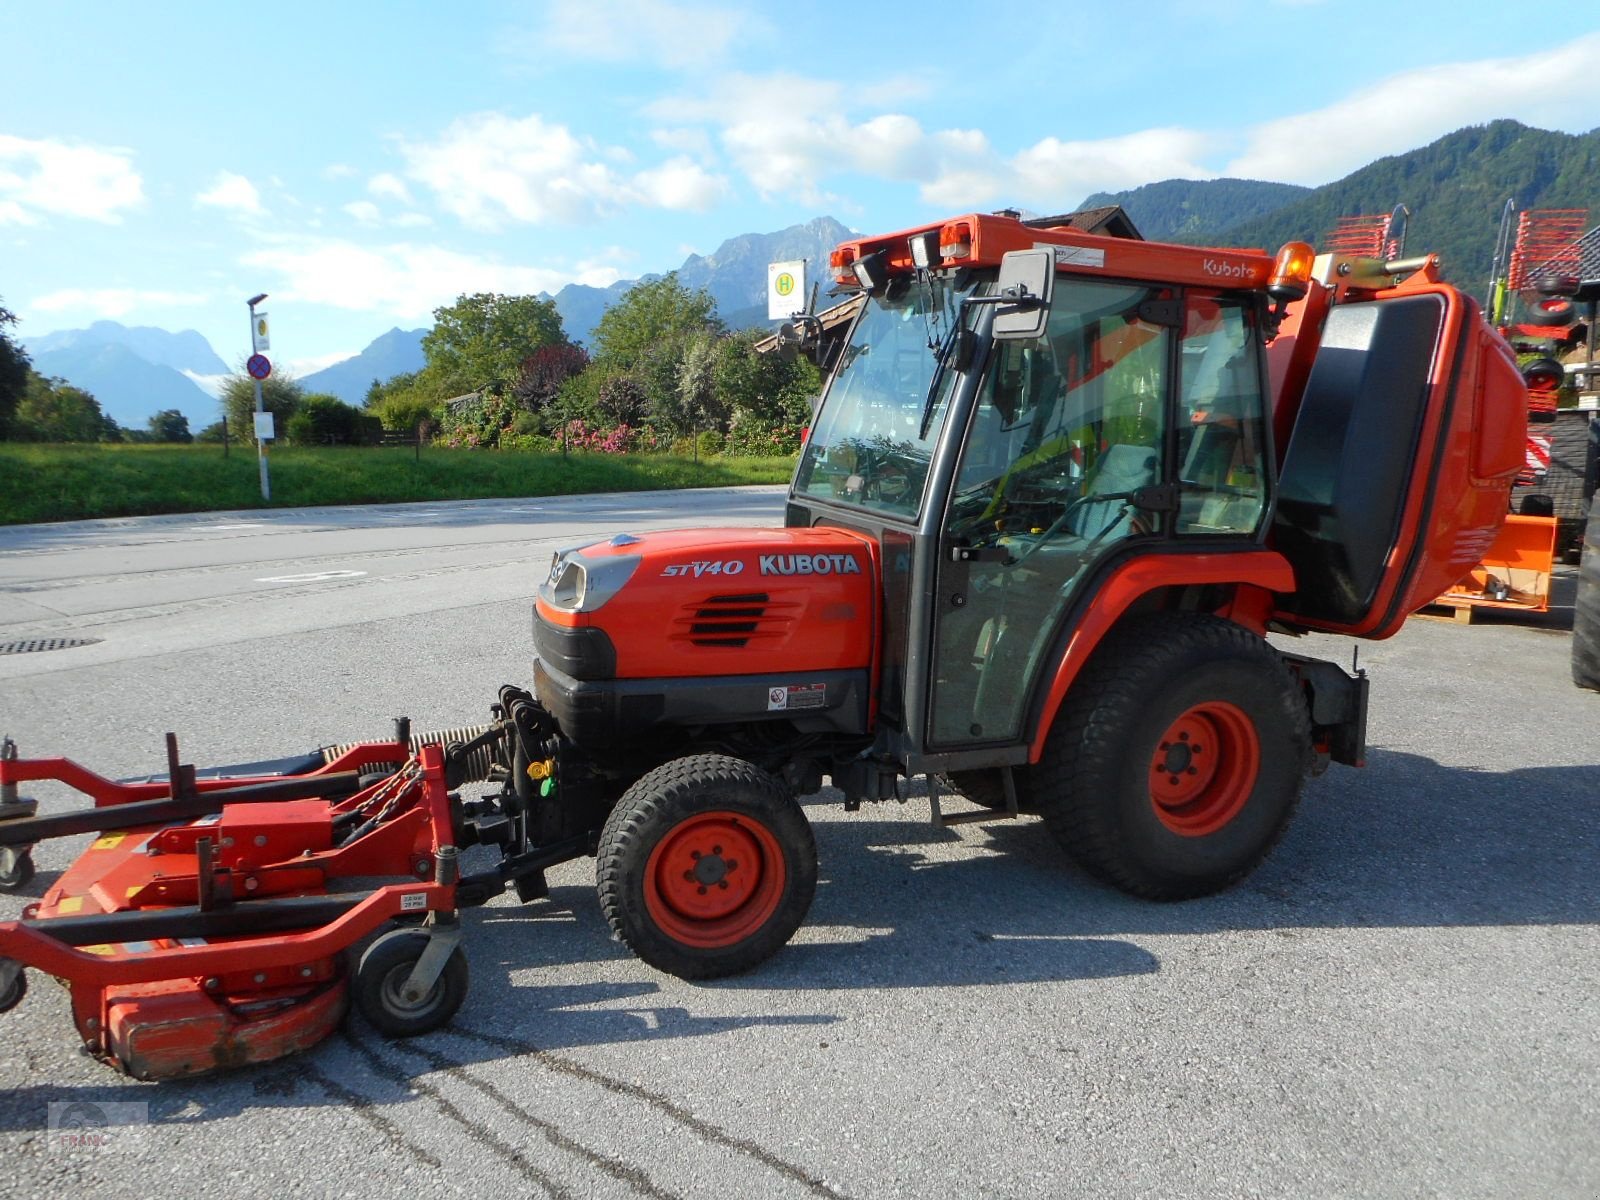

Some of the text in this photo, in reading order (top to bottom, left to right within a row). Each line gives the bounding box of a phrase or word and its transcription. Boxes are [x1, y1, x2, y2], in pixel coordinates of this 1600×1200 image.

[1203, 259, 1257, 278] Kubota
[780, 276, 791, 291] H
[659, 560, 744, 578] STV40
[758, 553, 861, 577] KUBOTA
